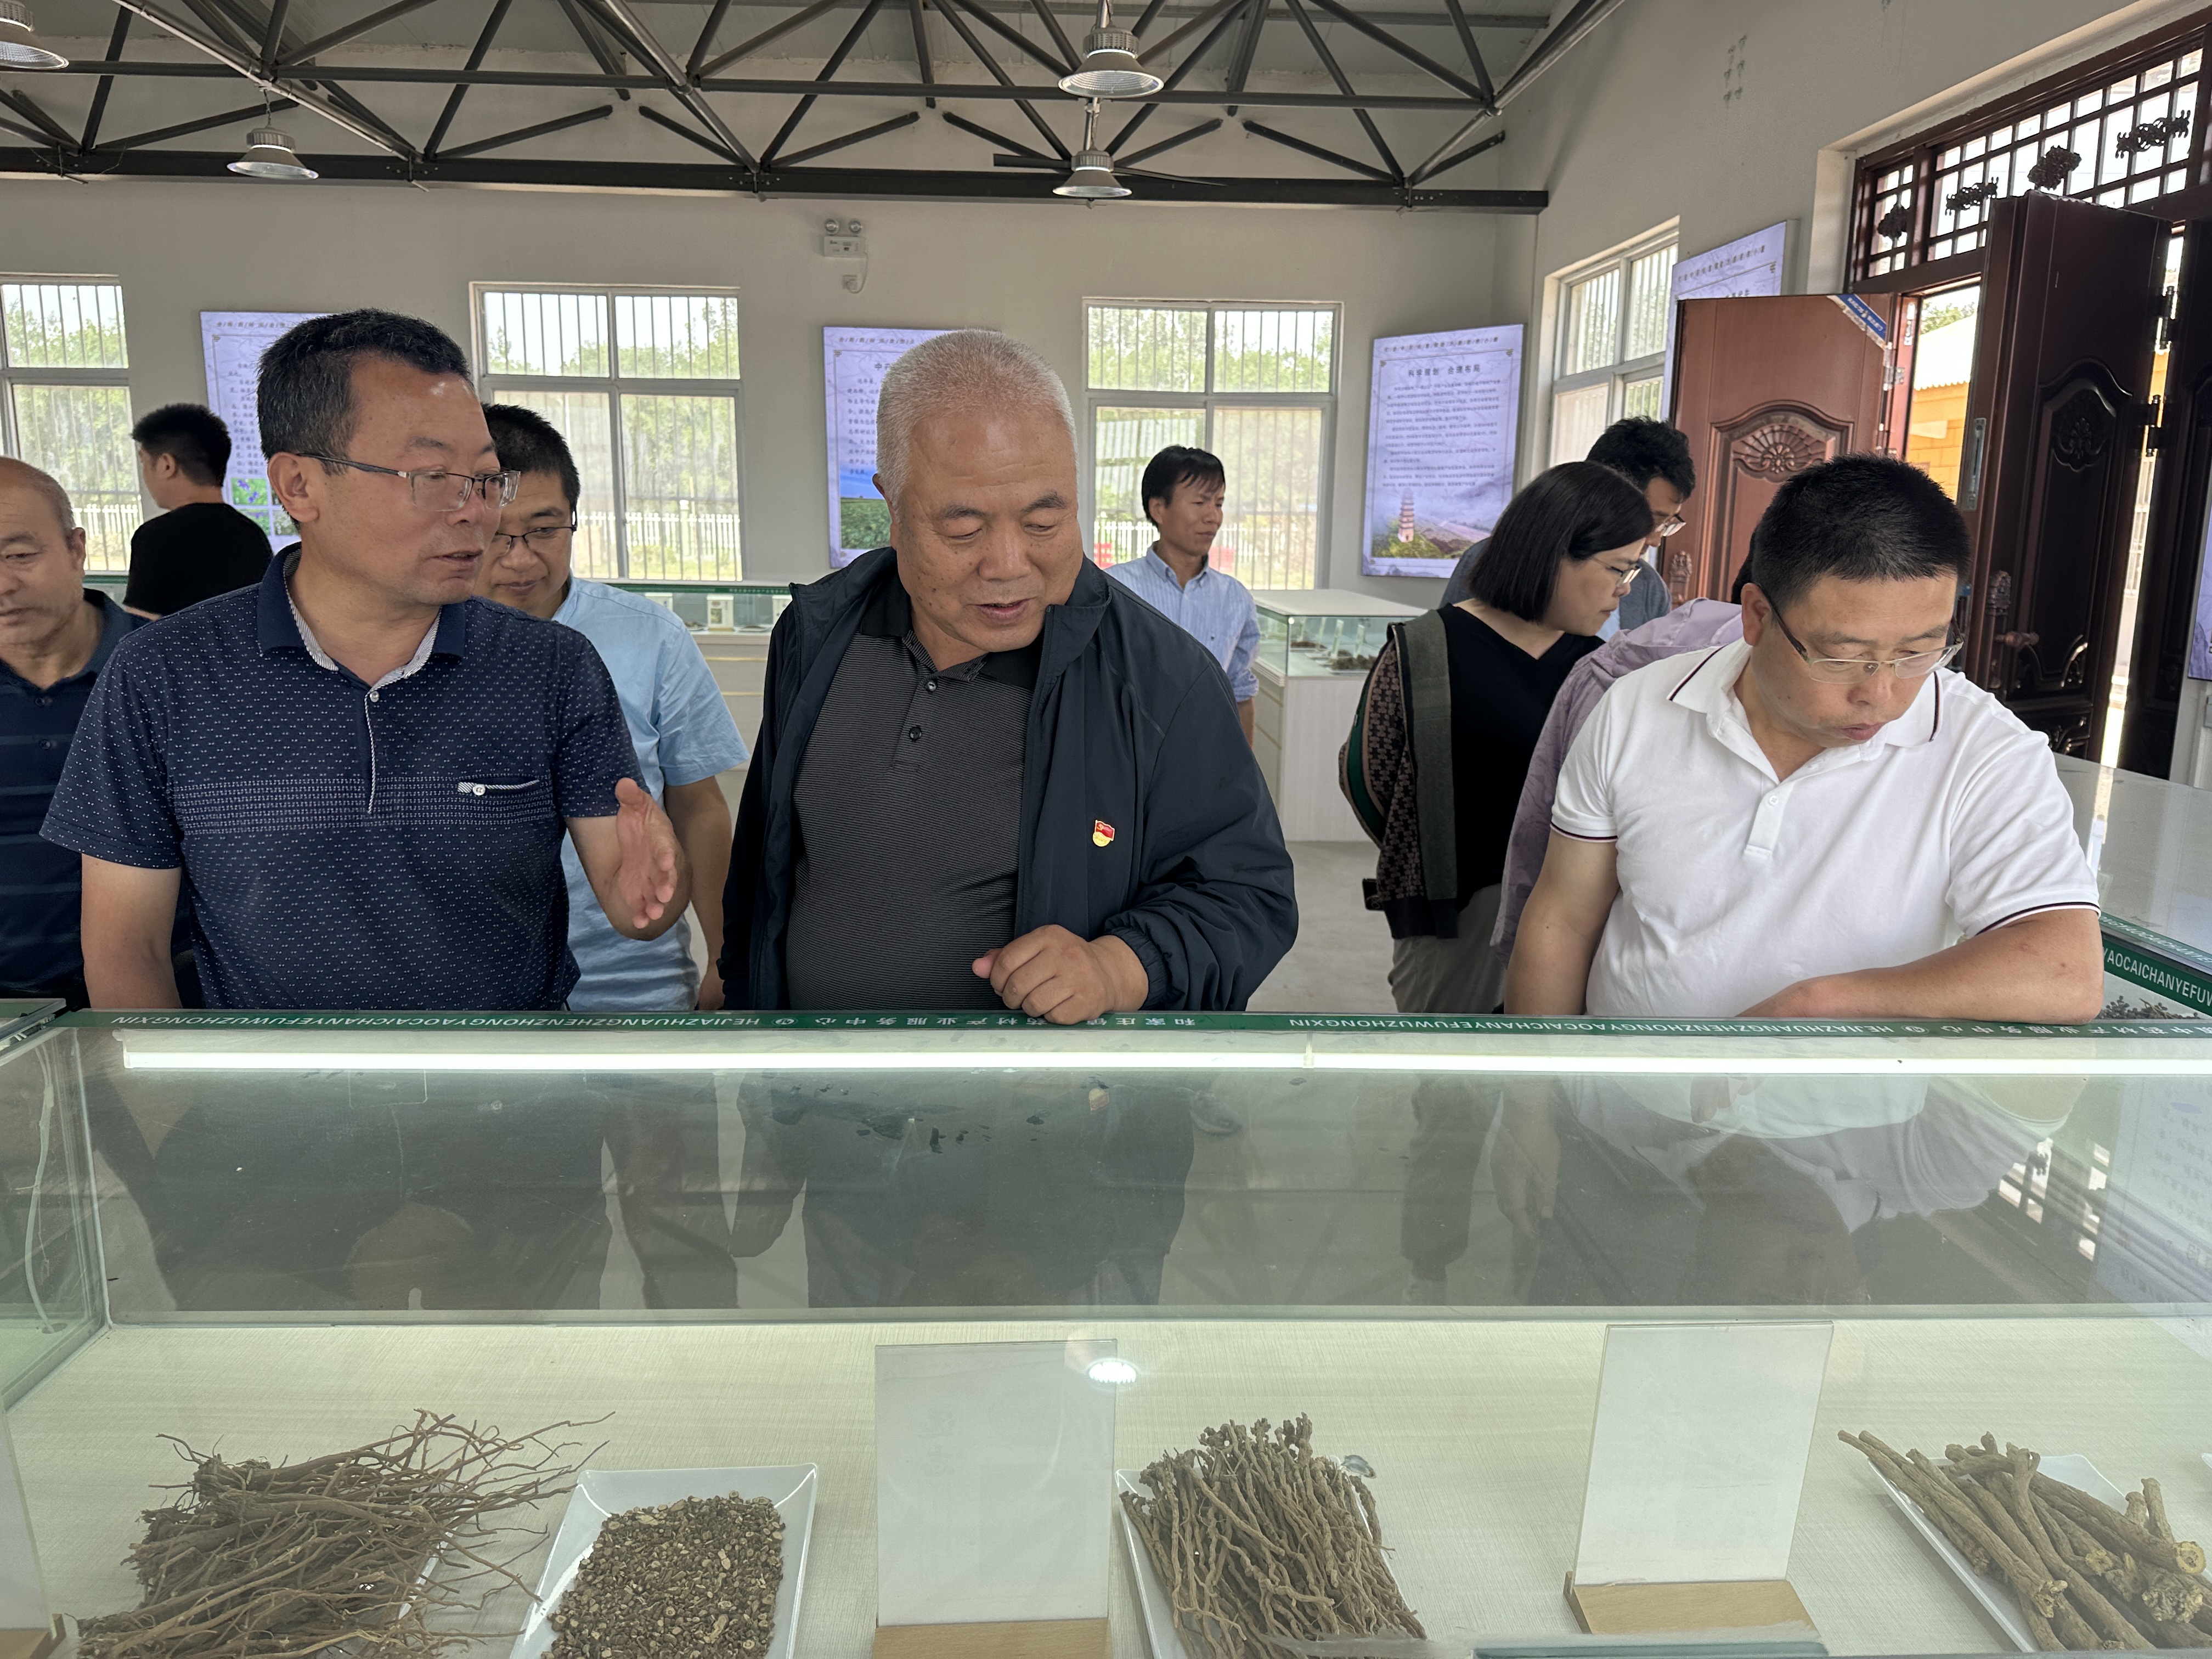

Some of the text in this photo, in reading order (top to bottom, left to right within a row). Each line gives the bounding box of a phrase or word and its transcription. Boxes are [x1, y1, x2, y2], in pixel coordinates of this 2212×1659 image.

[815, 1017, 1196, 1027] 和家庄镇药材产业服务中心
